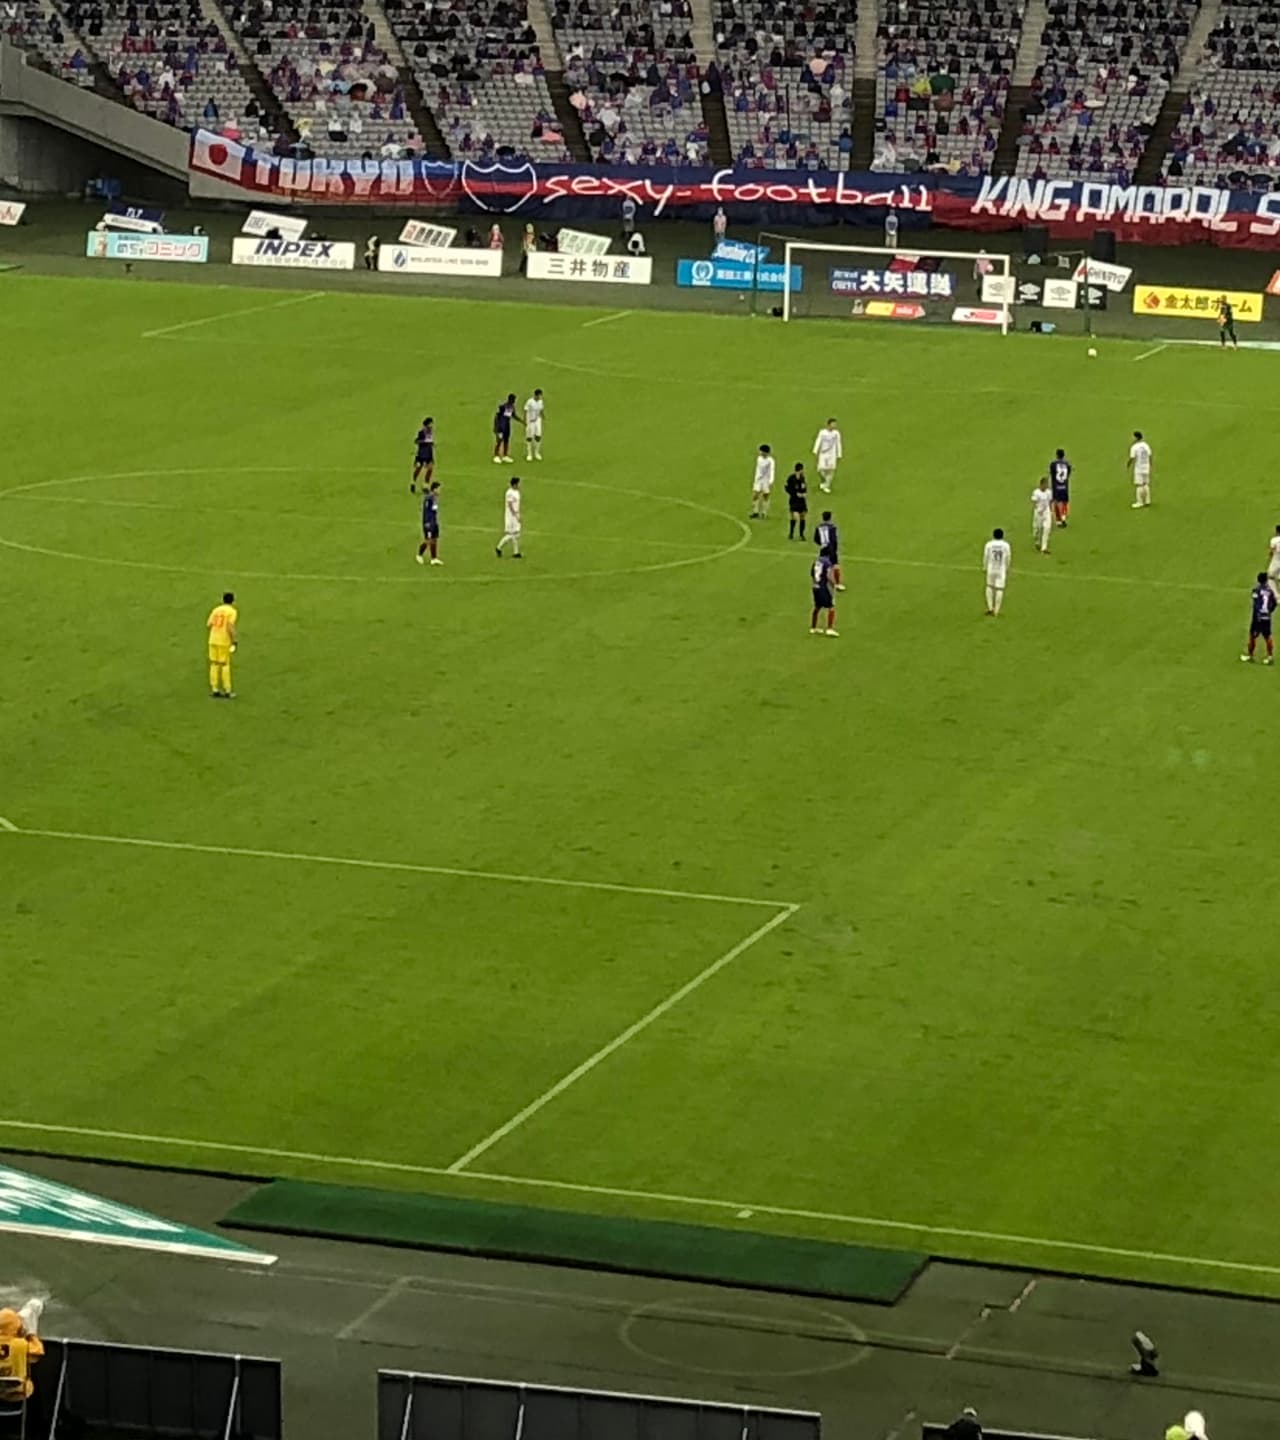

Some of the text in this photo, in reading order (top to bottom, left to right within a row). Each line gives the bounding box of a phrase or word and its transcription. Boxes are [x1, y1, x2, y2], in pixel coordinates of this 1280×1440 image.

[254, 152, 415, 194] TOKYO
[971, 175, 1072, 222] KING
[1075, 181, 1238, 234] AMARAL
[255, 240, 334, 258] INPEX
[548, 257, 631, 279] 三井物産
[860, 269, 952, 296] 大矢運送
